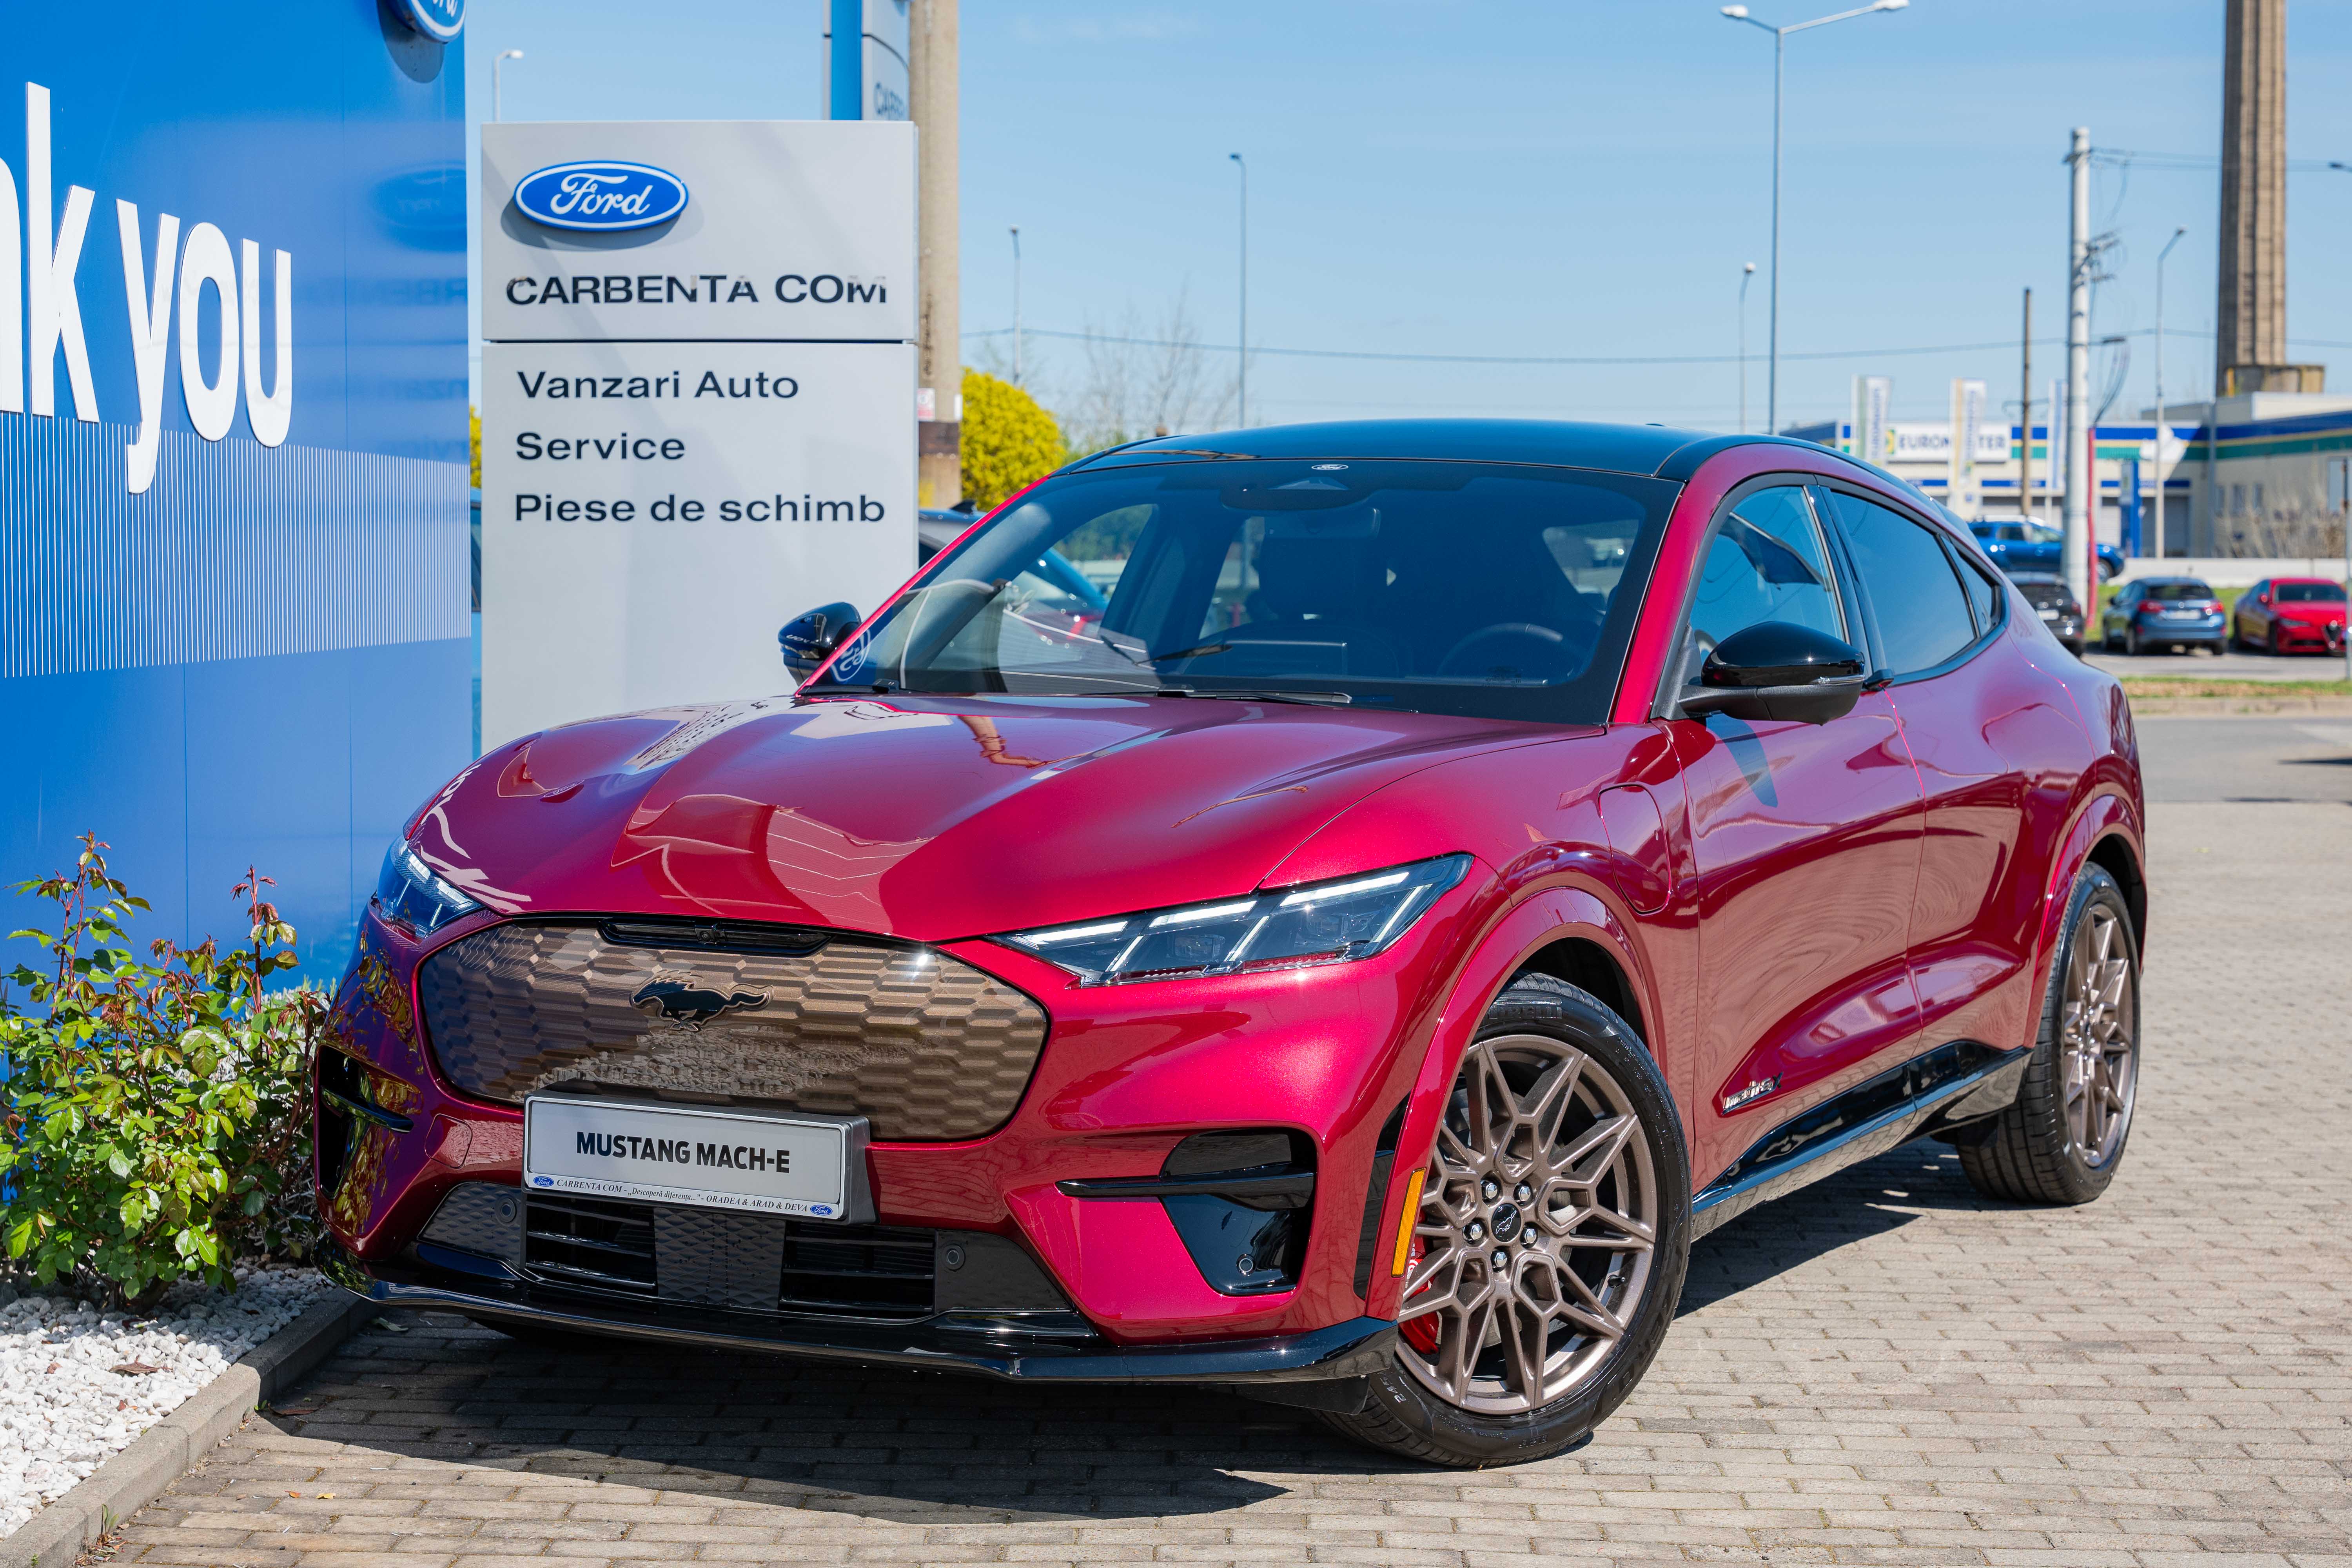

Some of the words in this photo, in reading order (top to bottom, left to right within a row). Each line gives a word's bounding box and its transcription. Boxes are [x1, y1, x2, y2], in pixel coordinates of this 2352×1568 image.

[550, 173, 653, 215] Ford
[507, 276, 759, 306] CARBENTA
[116, 198, 292, 494] you
[517, 371, 679, 399] Vanzari
[695, 371, 799, 399] Auto
[516, 432, 685, 461] Service
[516, 494, 635, 522] Piese
[650, 494, 705, 522] de
[720, 495, 885, 522] schimb
[577, 1131, 690, 1164] MUSTANG
[697, 1142, 790, 1174] MACH-E
[557, 1179, 601, 1191] CARBENTA
[603, 1184, 623, 1193] COM
[706, 1195, 740, 1205] ORADEA
[750, 1200, 774, 1209] ARAD
[784, 1203, 808, 1212] DEVA
[814, 1206, 829, 1214] Ford
